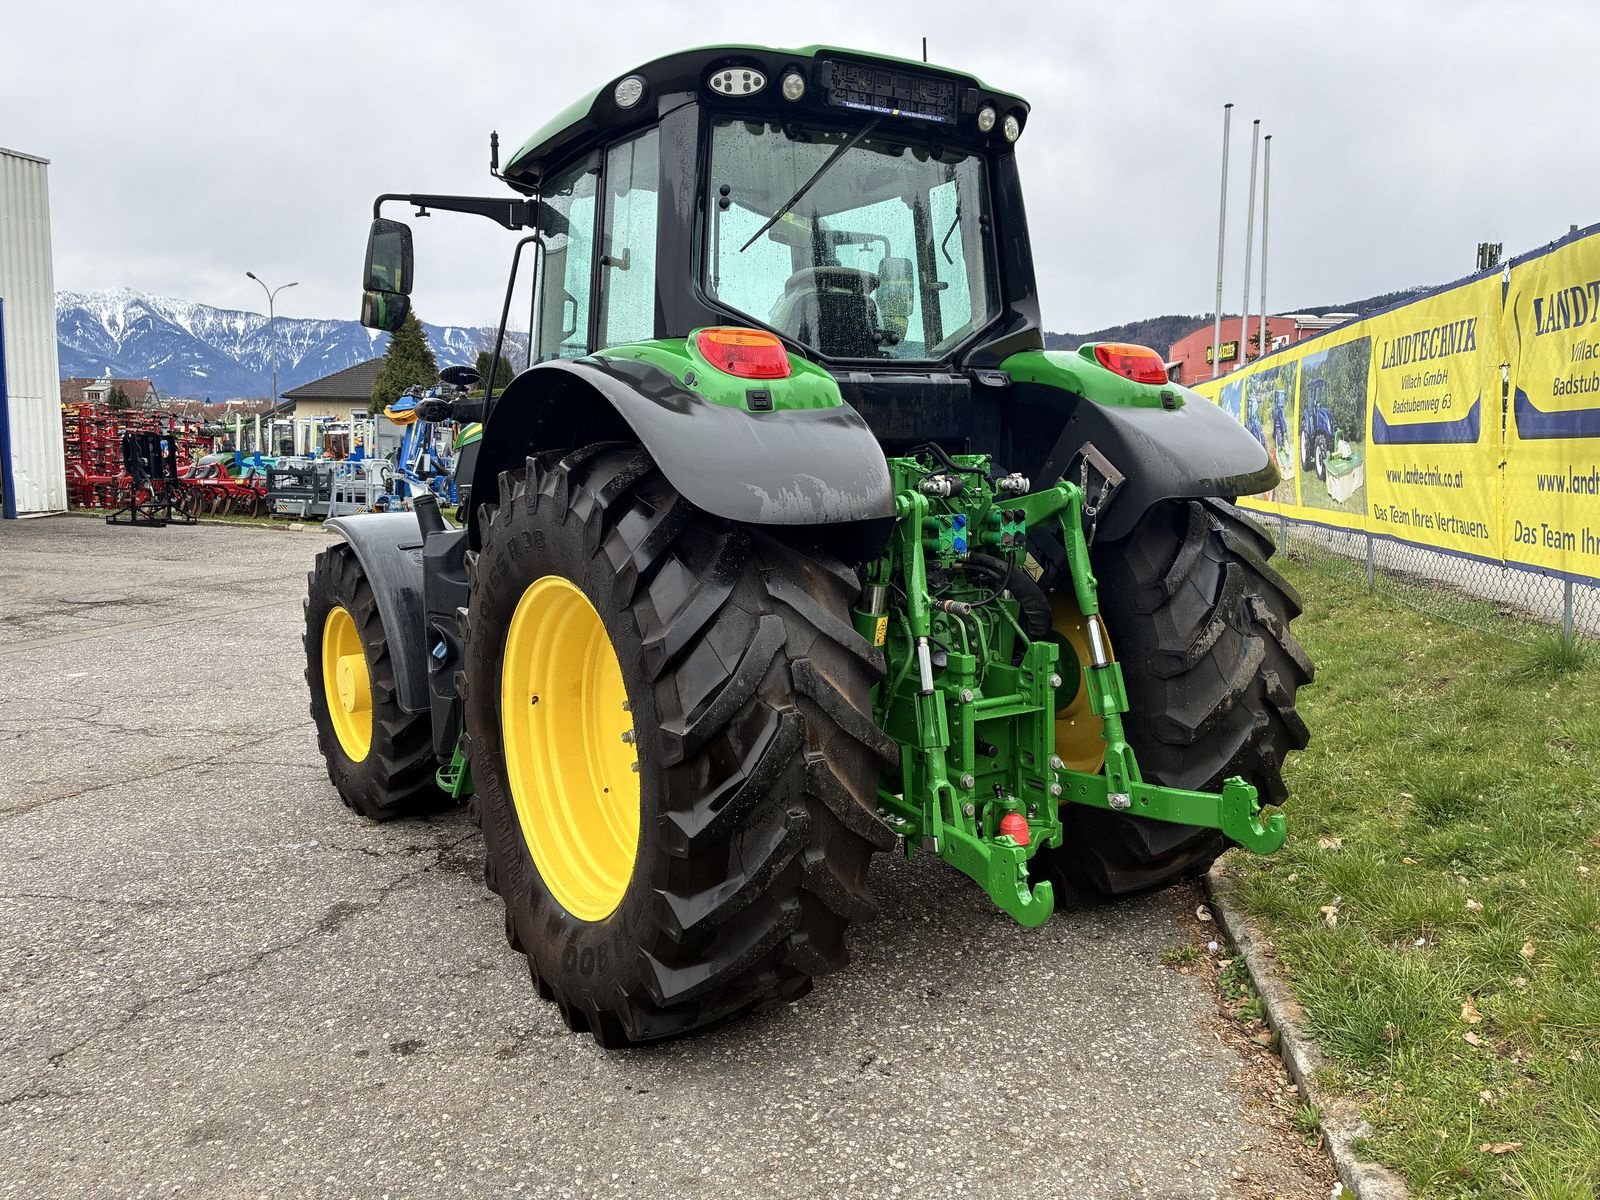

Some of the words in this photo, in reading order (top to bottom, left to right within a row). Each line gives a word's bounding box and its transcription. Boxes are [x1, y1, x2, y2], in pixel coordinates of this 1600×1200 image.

[1381, 317, 1478, 370] LANDTECHNIK
[1401, 372, 1421, 390] Villach
[1423, 369, 1449, 387] GmbH
[1553, 371, 1600, 396] Badstub
[1392, 396, 1440, 414] Badstubenweg
[1442, 393, 1452, 409] 63
[1386, 463, 1464, 489] www.landtechnik.co.at
[1373, 503, 1388, 522] Das
[1389, 505, 1410, 526] Team
[1412, 507, 1434, 529] Ihres
[1434, 511, 1489, 539] Vertrauens
[1514, 520, 1537, 545] Das
[1541, 523, 1576, 552] Team
